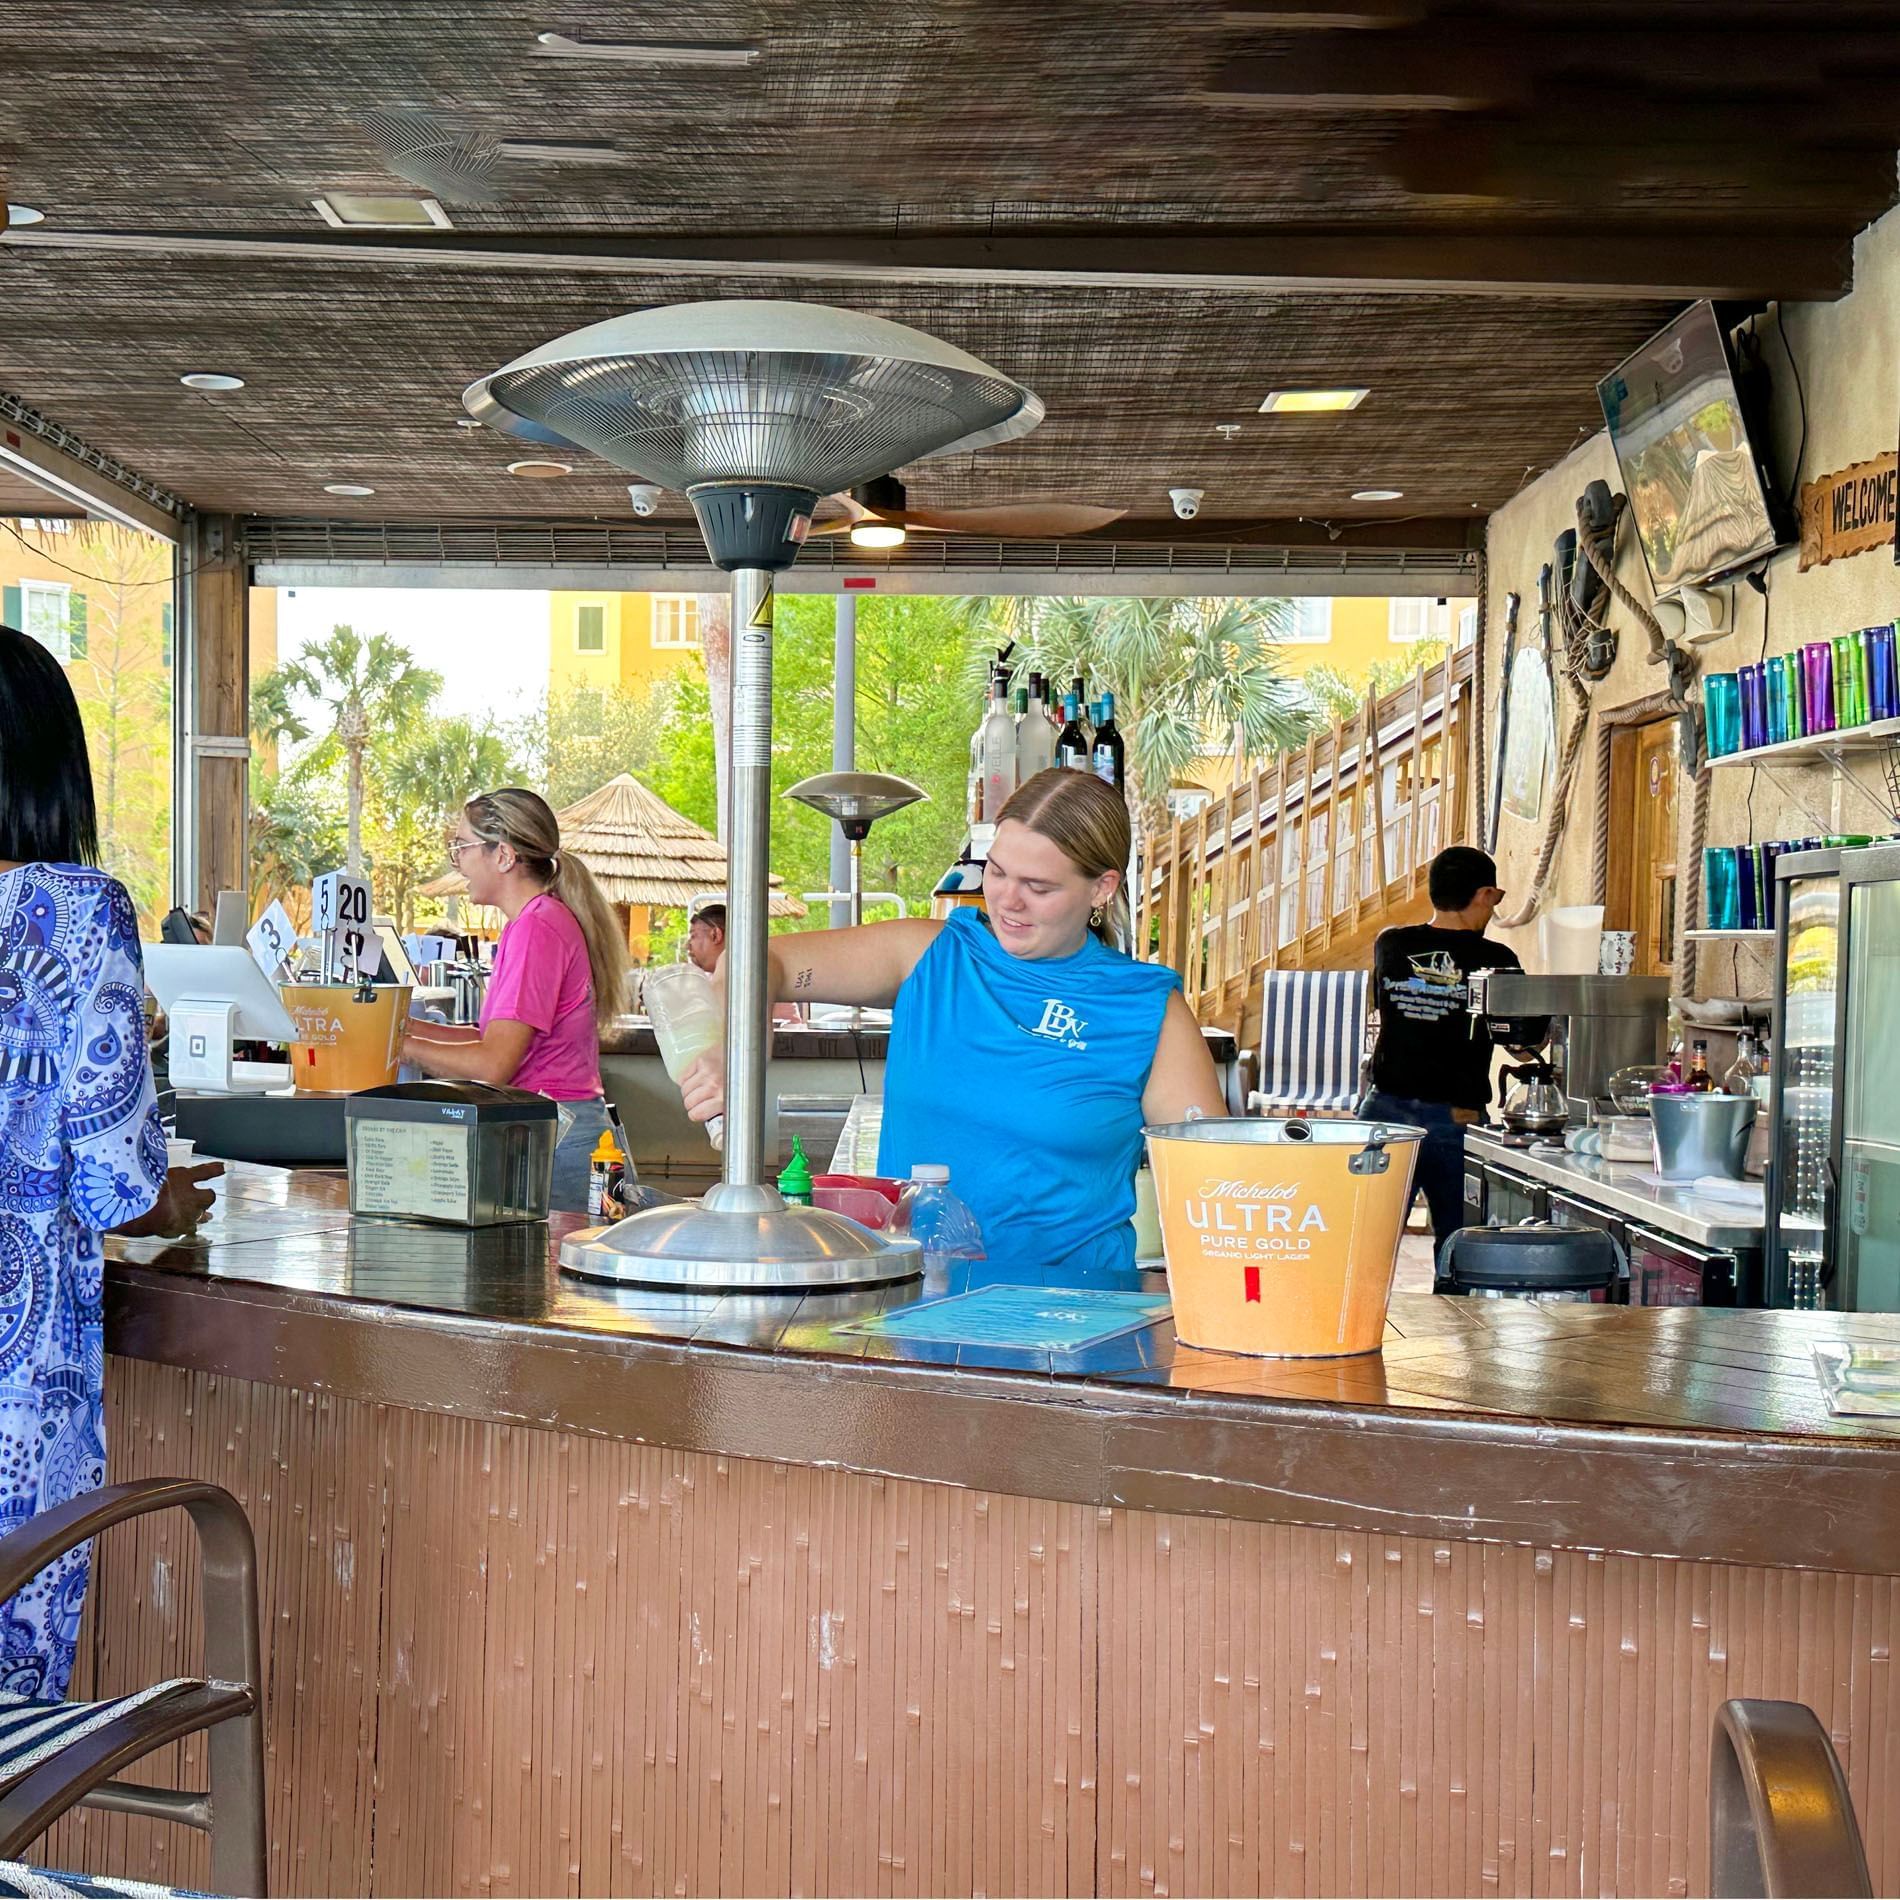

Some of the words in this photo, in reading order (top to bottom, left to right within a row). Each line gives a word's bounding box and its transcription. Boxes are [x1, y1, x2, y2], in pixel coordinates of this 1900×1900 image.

[1832, 469, 1896, 535] WELCOME
[320, 879, 329, 915] 5
[339, 883, 367, 924] 20
[261, 918, 281, 950] 3
[343, 931, 365, 957] 9
[436, 941, 443, 960] 1
[294, 1018, 345, 1032] LTRA
[1198, 1178, 1301, 1199] Michelob
[1185, 1199, 1329, 1233] ULTRA
[1200, 1234, 1249, 1249] PURE
[1255, 1238, 1311, 1250] GOLD
[1245, 1252, 1274, 1260] LIGHT
